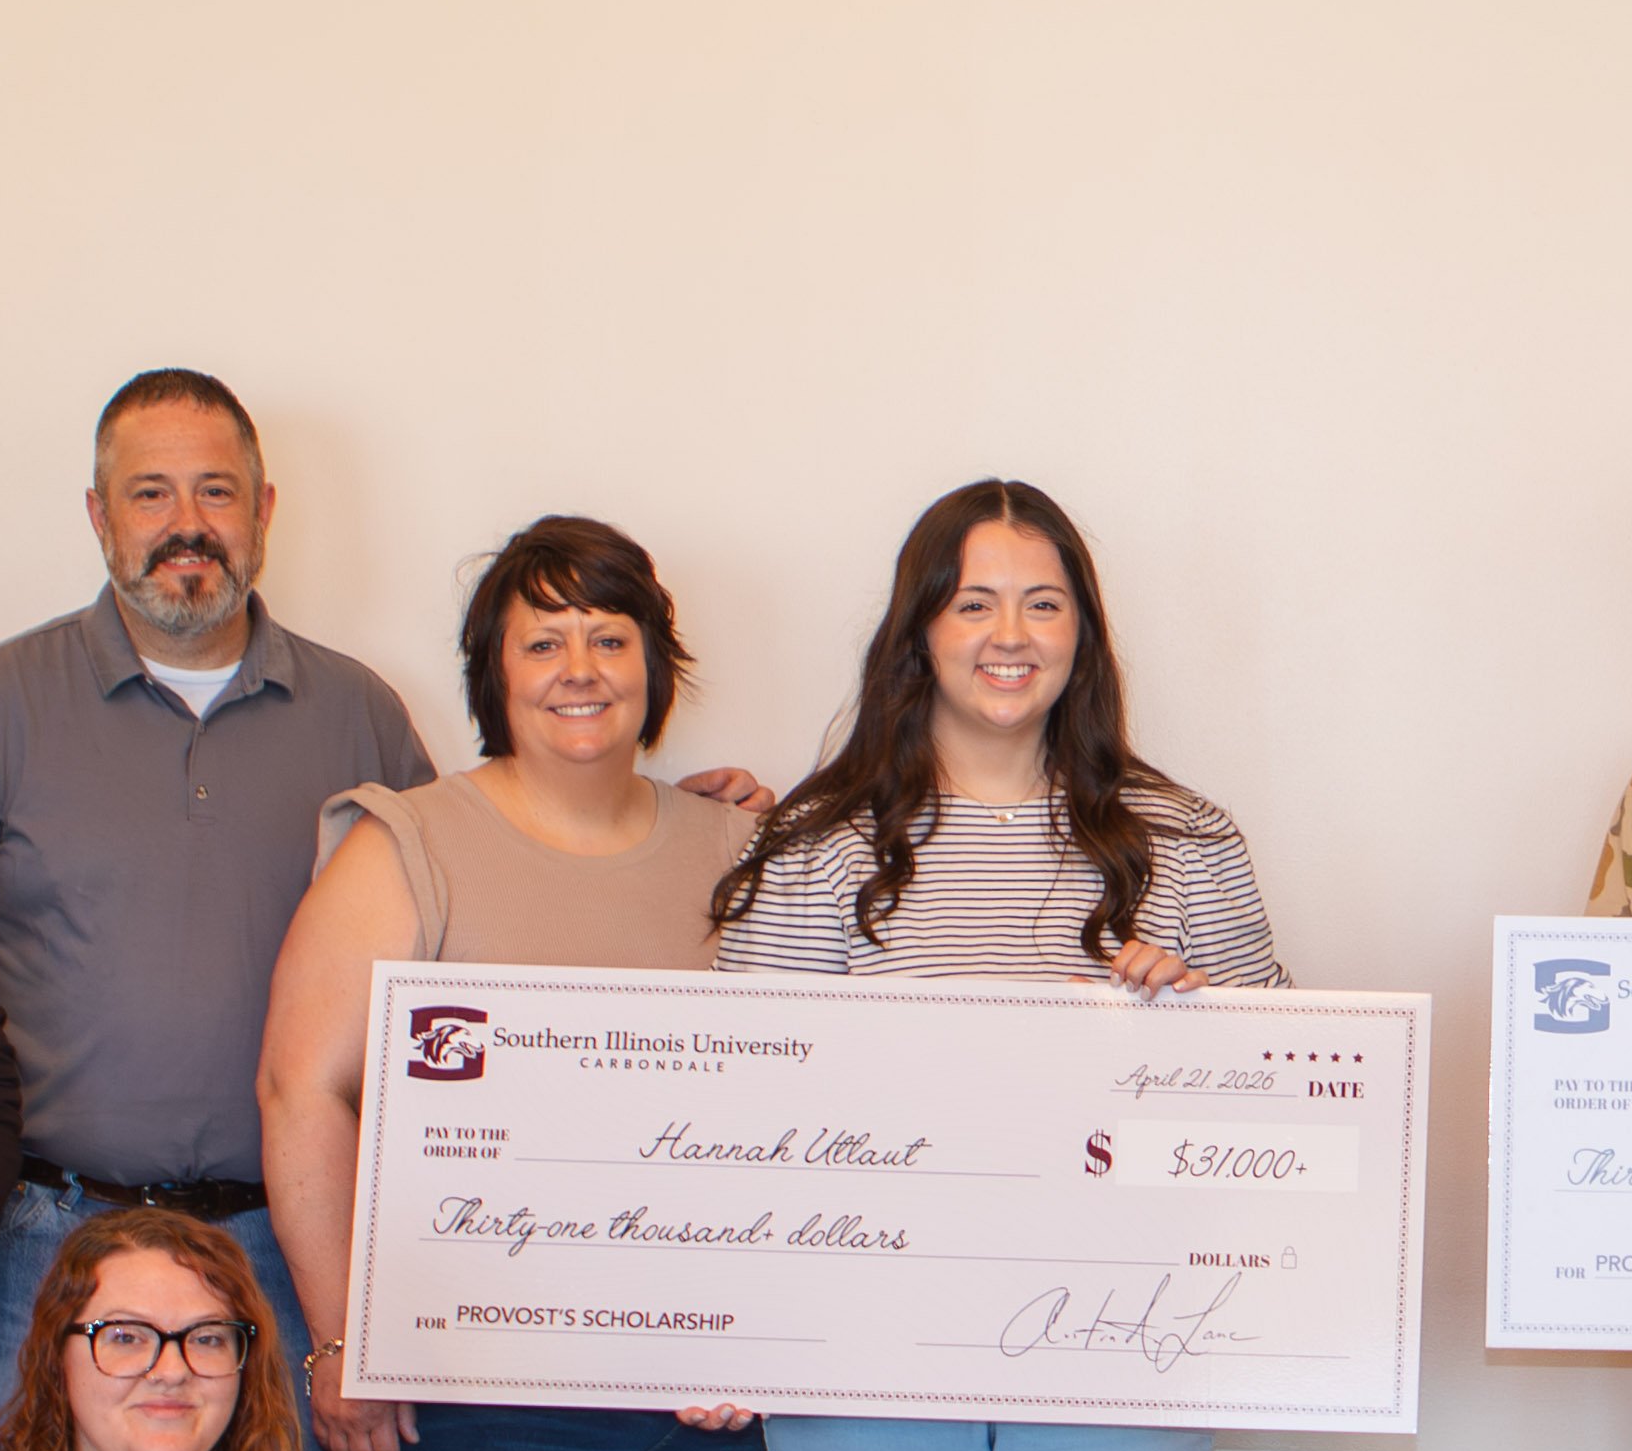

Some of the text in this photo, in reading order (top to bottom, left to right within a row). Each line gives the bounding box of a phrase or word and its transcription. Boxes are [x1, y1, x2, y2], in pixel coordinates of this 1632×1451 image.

[492, 1026, 815, 1063] Southern Illinois University
[579, 1057, 726, 1073] CARBONDALE
[1115, 1064, 1183, 1099] April
[1217, 1069, 1278, 1091] 2026
[1307, 1080, 1365, 1099] DATE
[1554, 1078, 1582, 1092] PAY
[1585, 1079, 1605, 1093] TO
[1554, 1096, 1632, 1111] ORDER OF
[425, 1126, 511, 1142] PAY TO THE
[639, 1121, 794, 1163] Hannah
[423, 1144, 502, 1160] ORDER OF
[1084, 1128, 1112, 1178] $
[432, 1196, 910, 1257] Thirty-one thousand+ dollars
[1188, 1252, 1270, 1268] DOLLARS
[1555, 1265, 1586, 1280] FOR
[415, 1304, 734, 1332] FOR PROVOST'S SCHOLARSHIP
